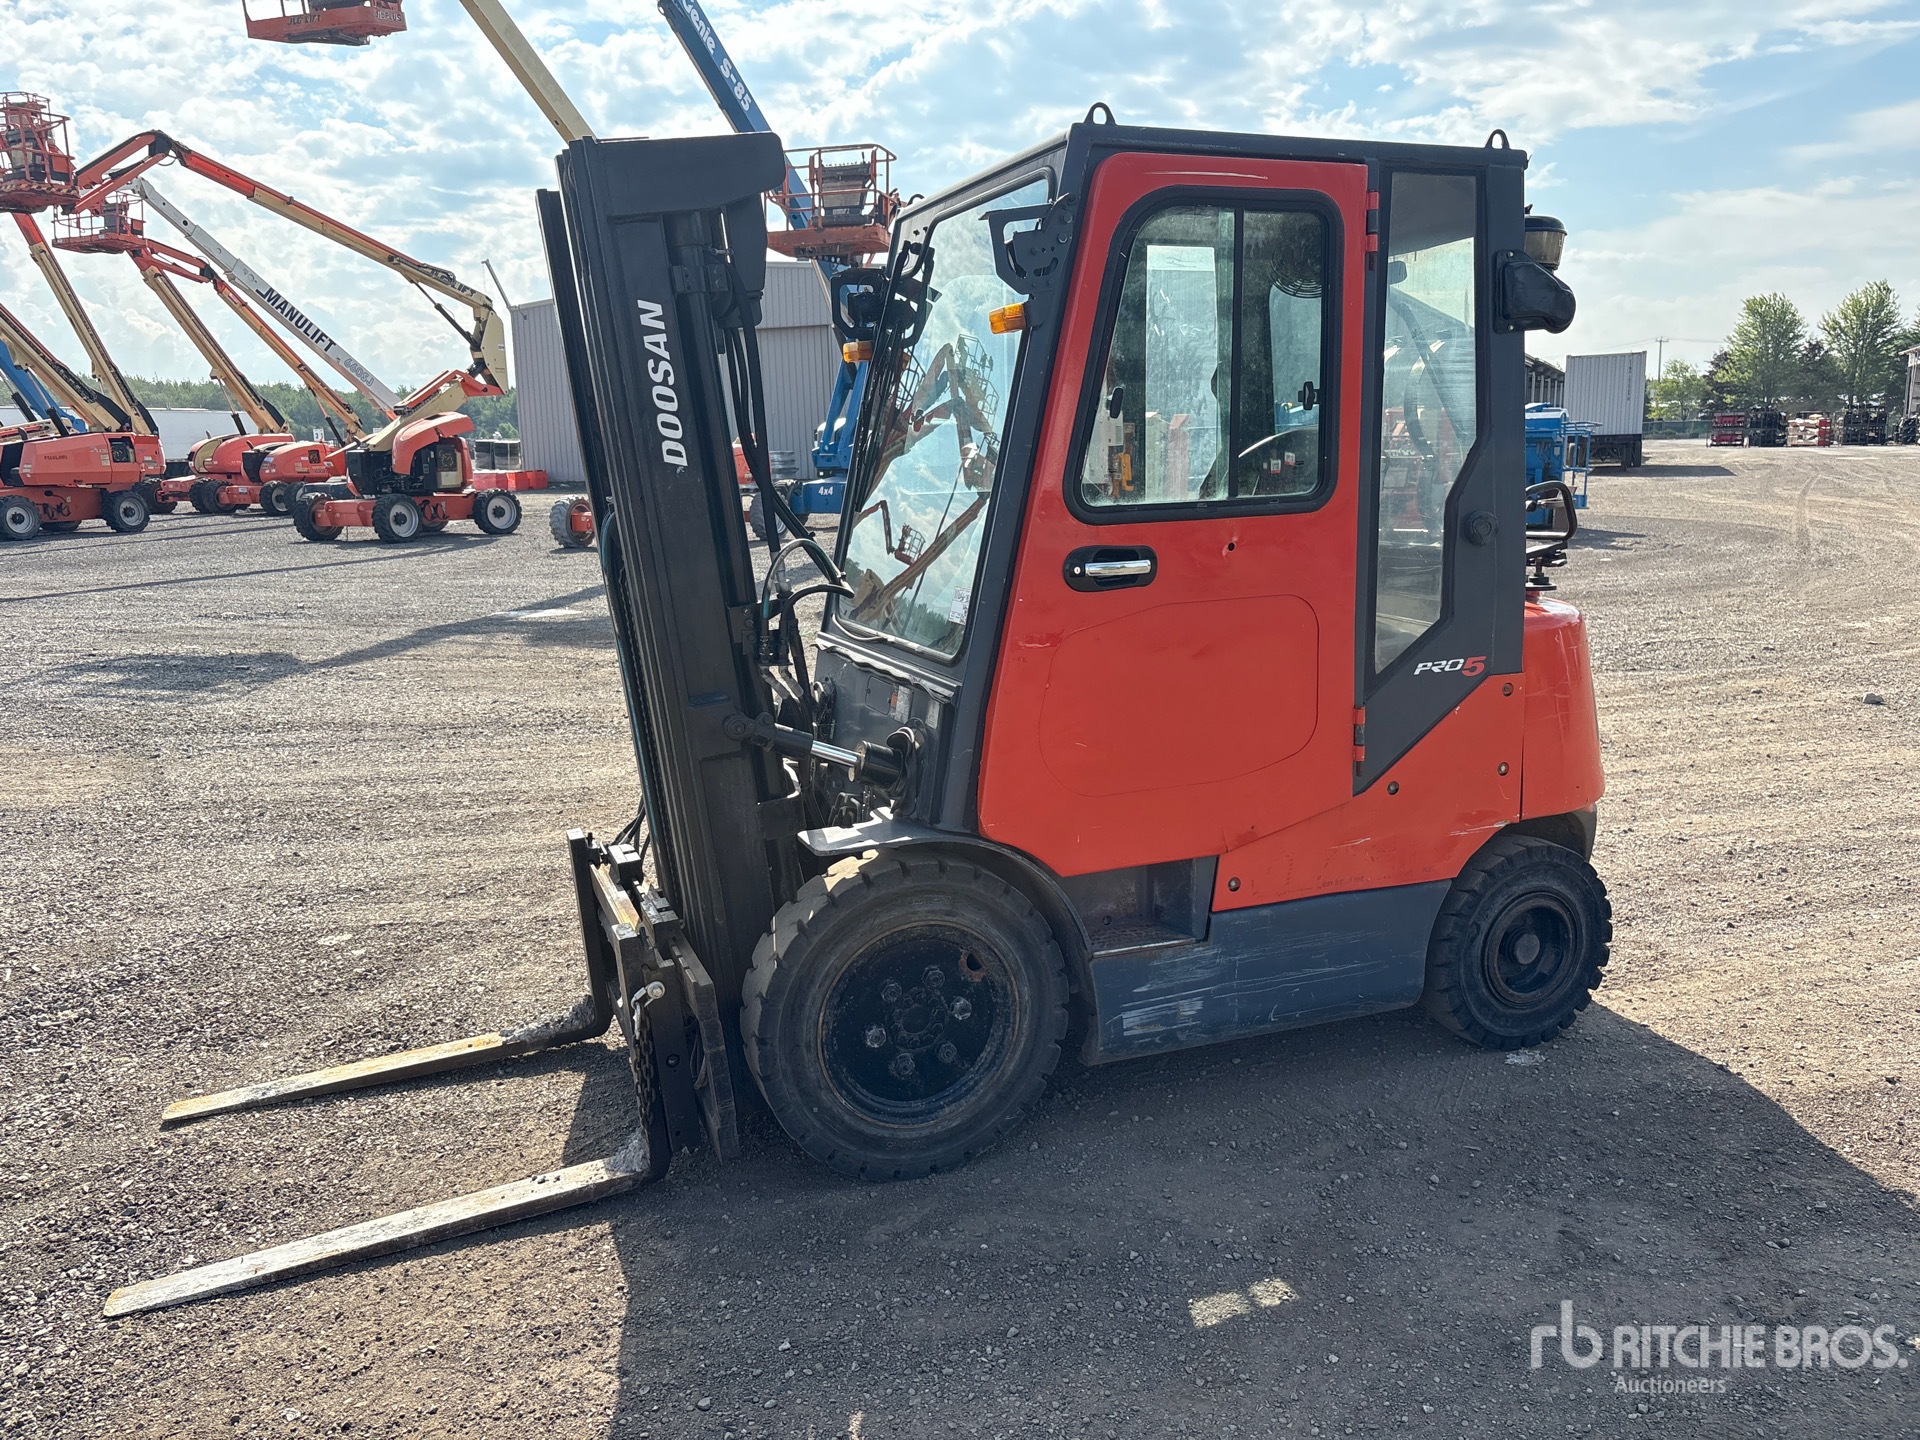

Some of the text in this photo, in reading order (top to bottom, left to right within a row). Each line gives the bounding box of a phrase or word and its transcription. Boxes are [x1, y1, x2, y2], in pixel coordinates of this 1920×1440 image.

[720, 58, 752, 111] S-85
[256, 287, 336, 352] MANULIFT
[343, 358, 375, 387] 660SJ
[637, 299, 688, 467] DOOSAN
[818, 486, 834, 496] 4x4
